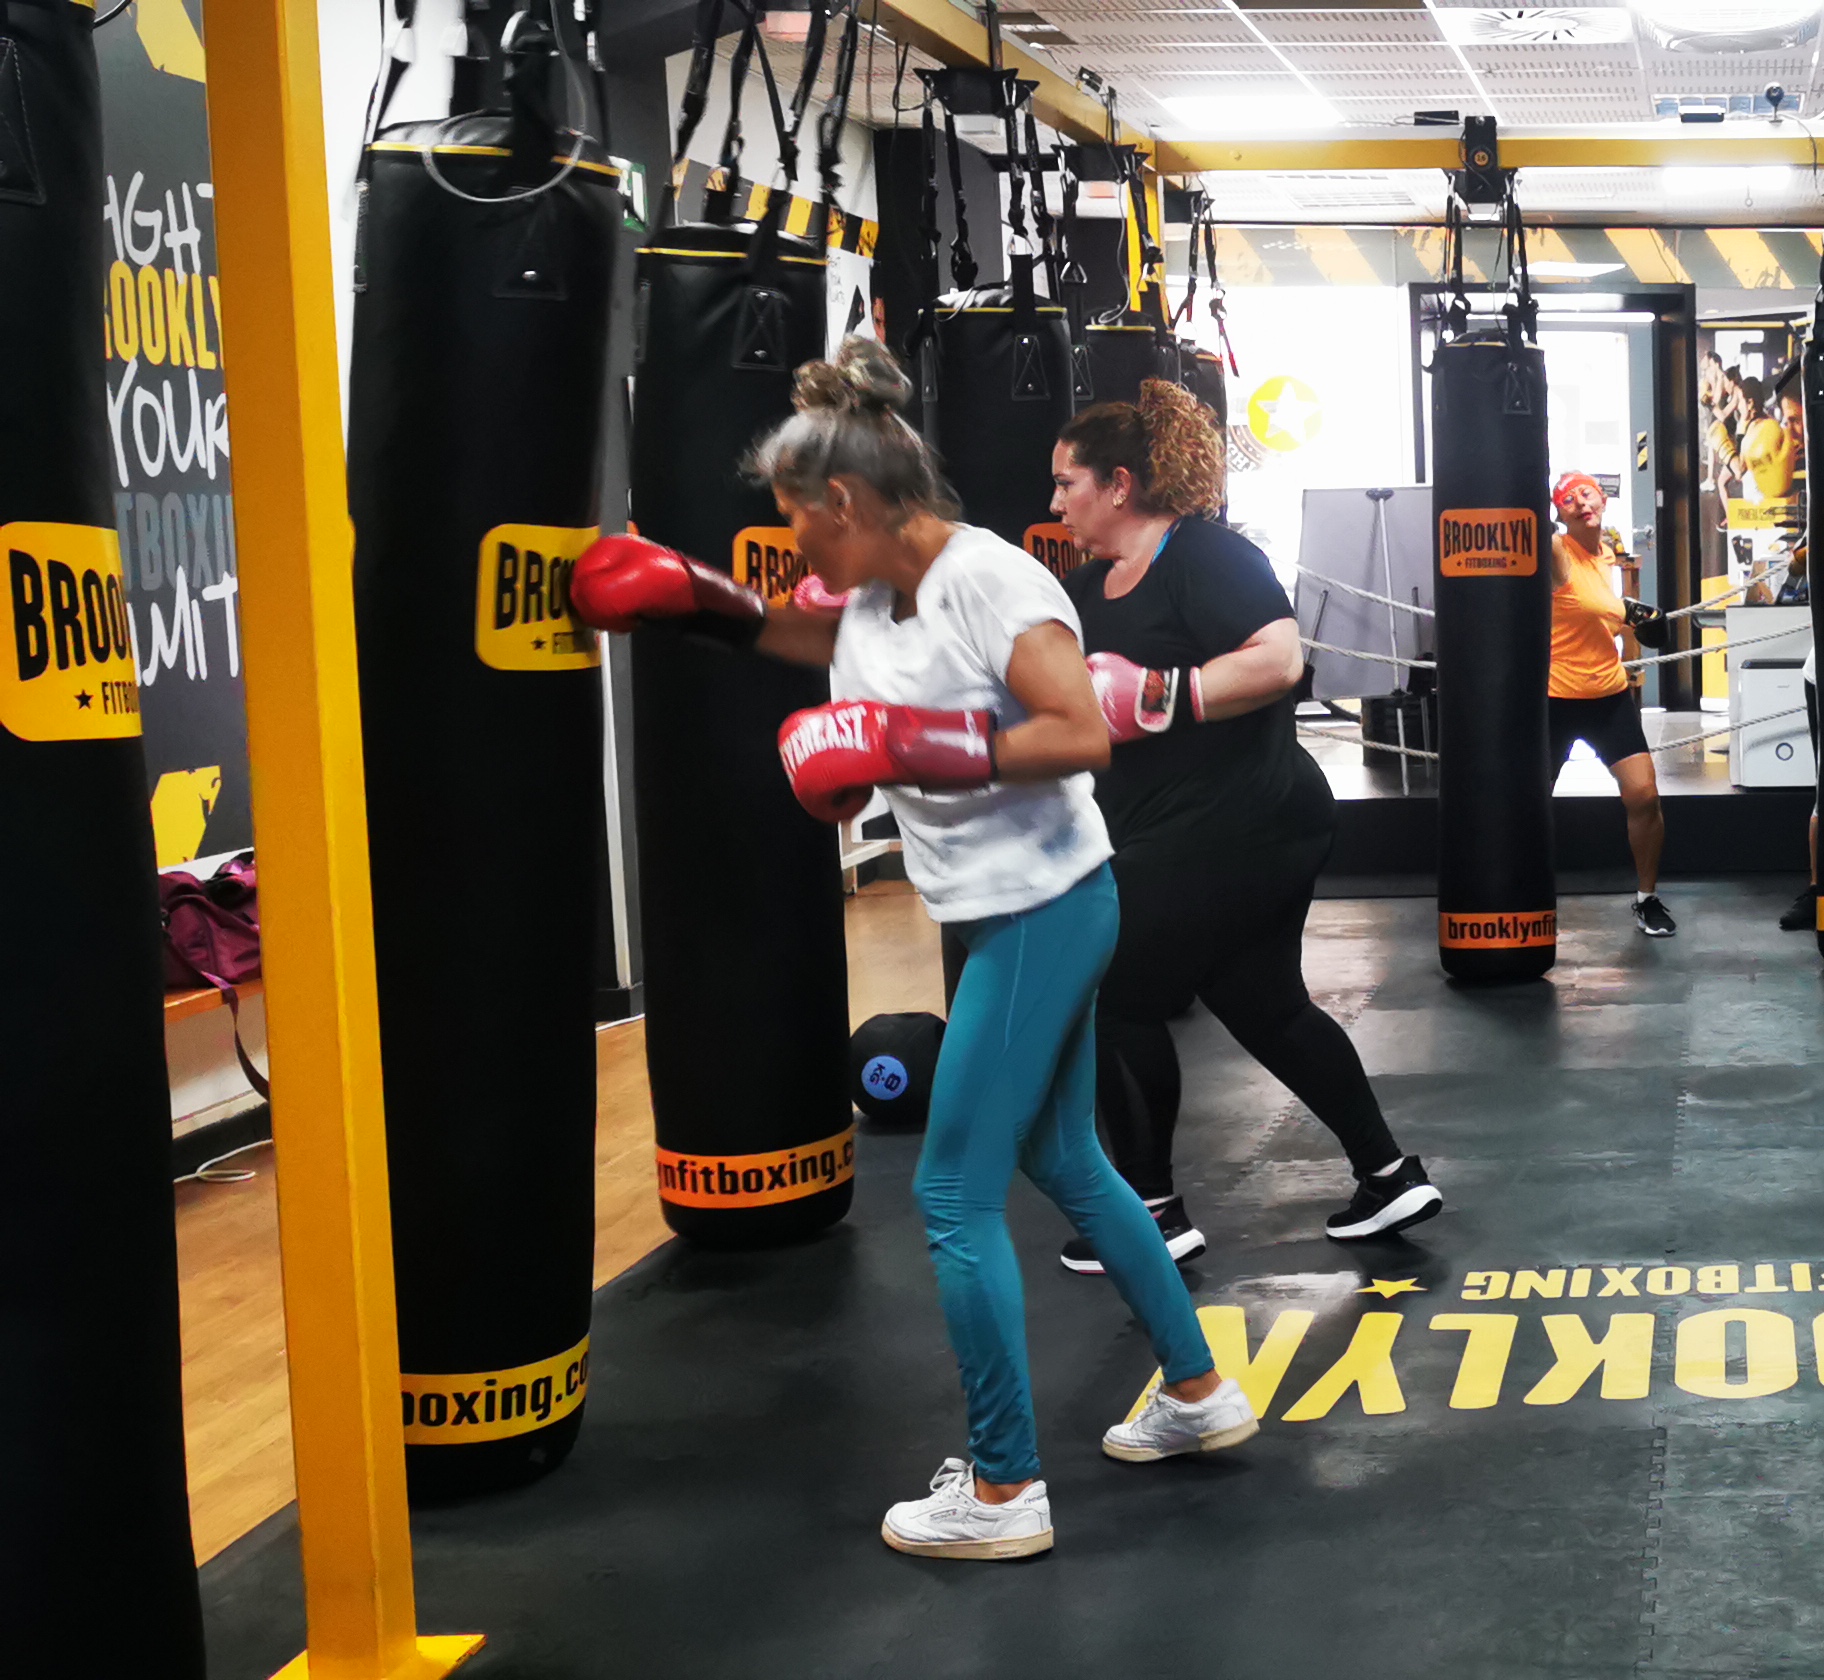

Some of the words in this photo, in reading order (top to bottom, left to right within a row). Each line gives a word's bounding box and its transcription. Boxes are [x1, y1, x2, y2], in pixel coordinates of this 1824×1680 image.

[1443, 517, 1532, 558] BROOKLYN
[9, 549, 132, 682] BROO
[127, 564, 239, 687] IMIT
